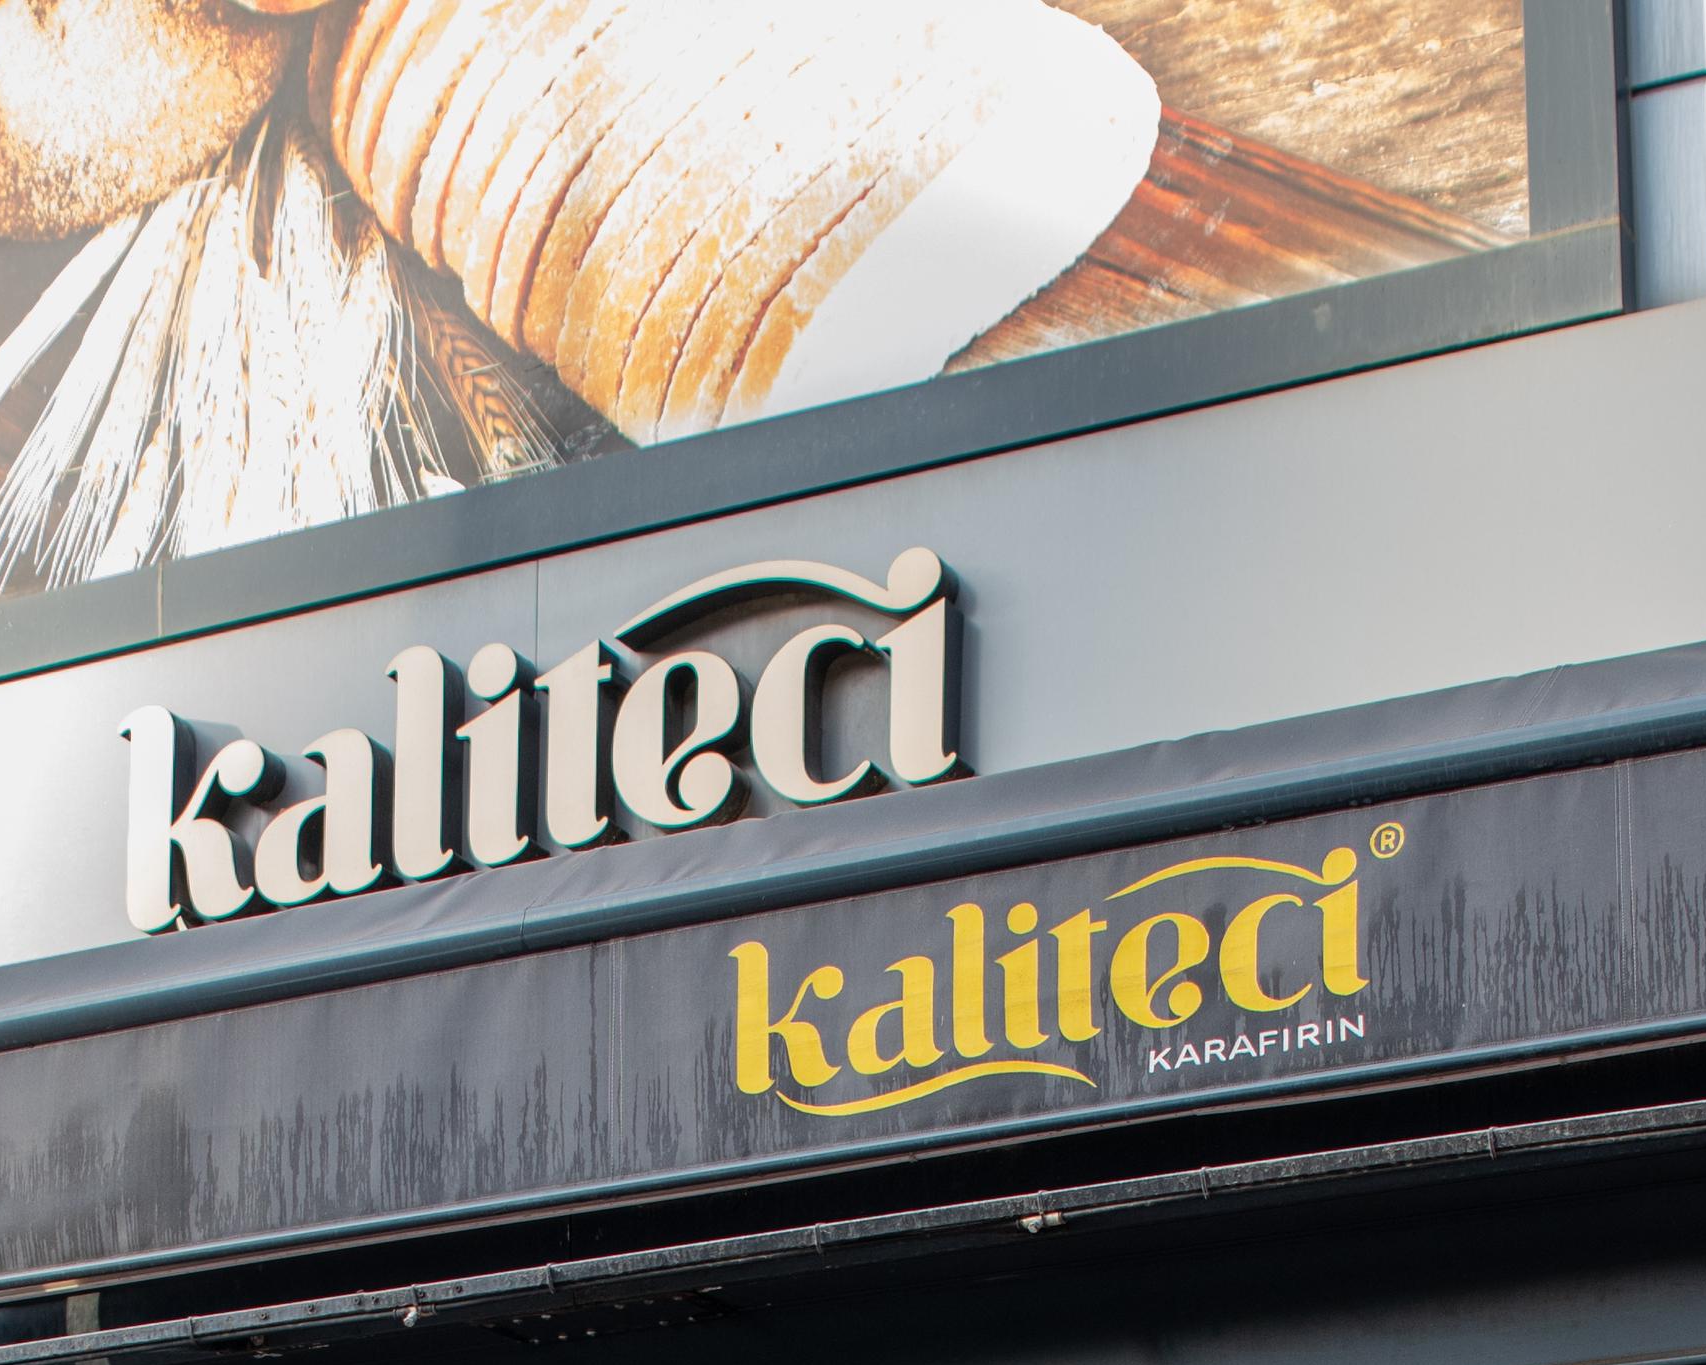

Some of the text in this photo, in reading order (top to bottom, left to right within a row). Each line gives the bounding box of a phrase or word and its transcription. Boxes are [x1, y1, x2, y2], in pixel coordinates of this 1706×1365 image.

[121, 546, 963, 934] kaliteci
[730, 847, 1370, 1117] kaliteci
[1148, 1015, 1368, 1074] KARAFIRIN
